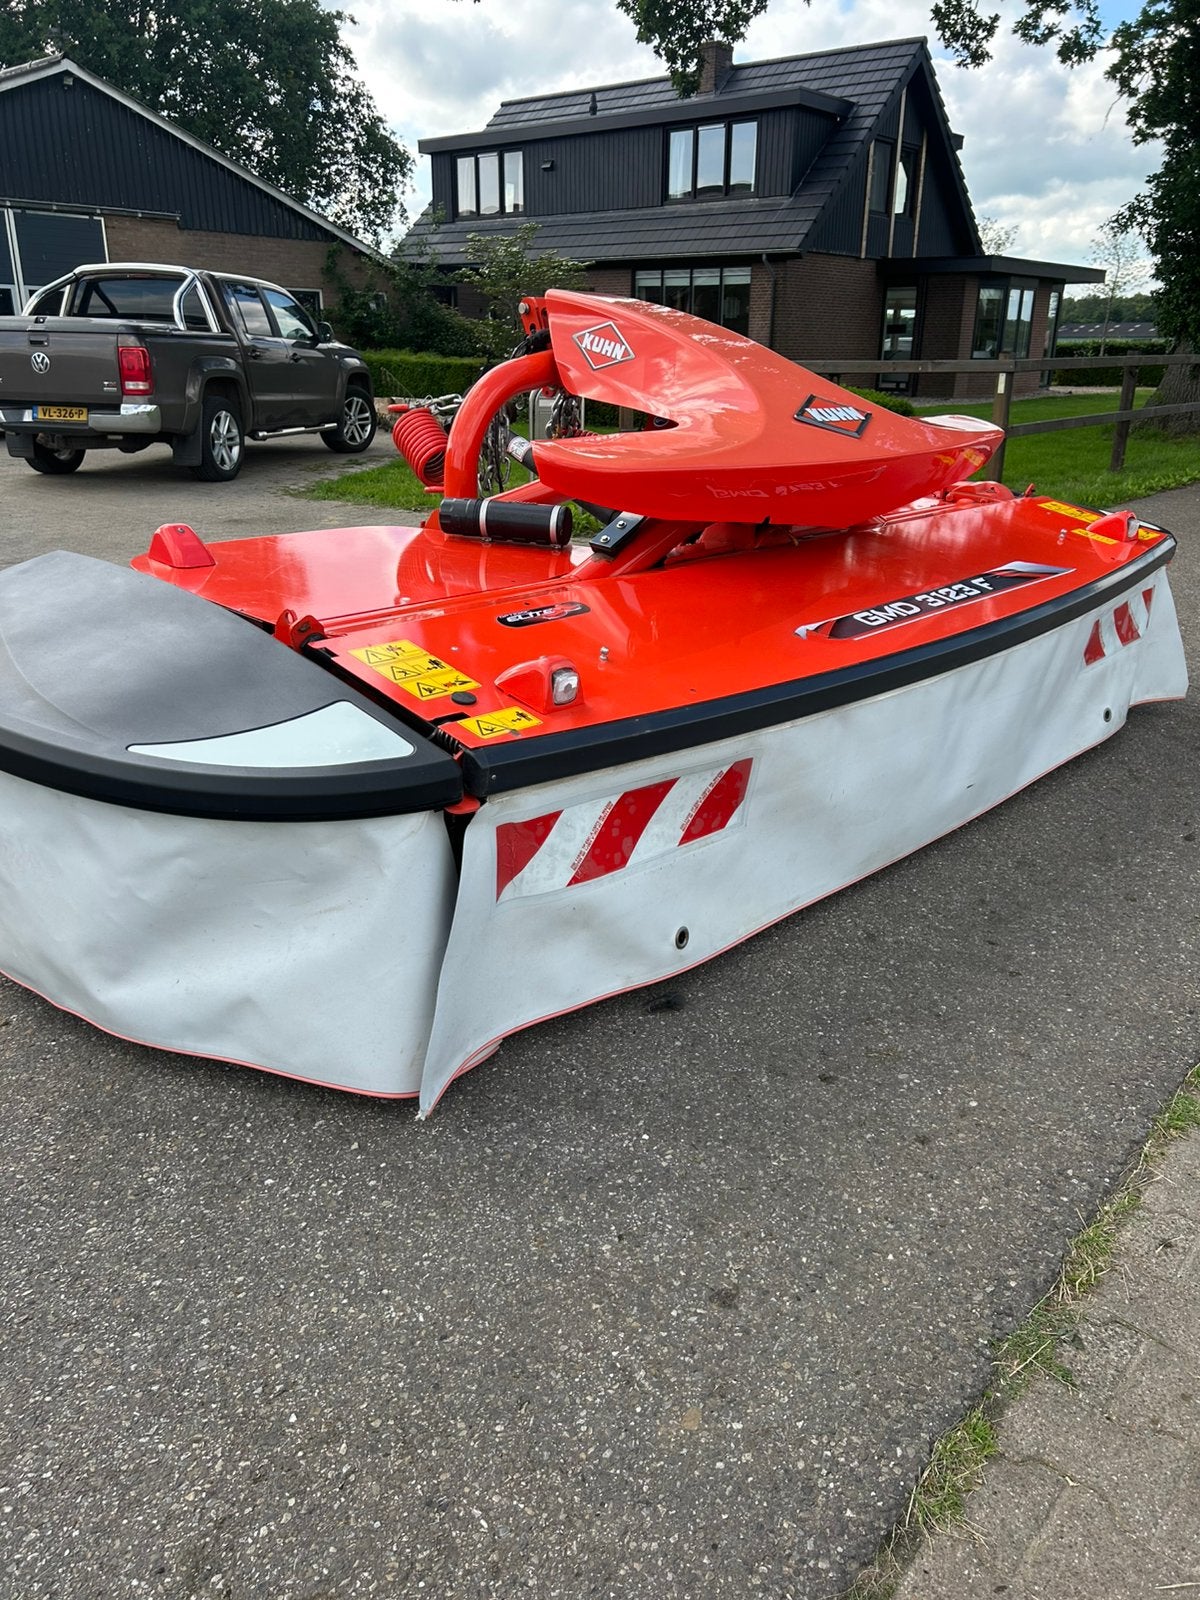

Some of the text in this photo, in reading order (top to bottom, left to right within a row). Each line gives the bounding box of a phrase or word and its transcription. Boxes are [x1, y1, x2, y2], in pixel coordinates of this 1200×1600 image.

[582, 332, 626, 360] KUHN
[41, 407, 84, 419] VL-326-P
[804, 406, 866, 422] KUHN
[853, 577, 994, 626] GMD 3123 F
